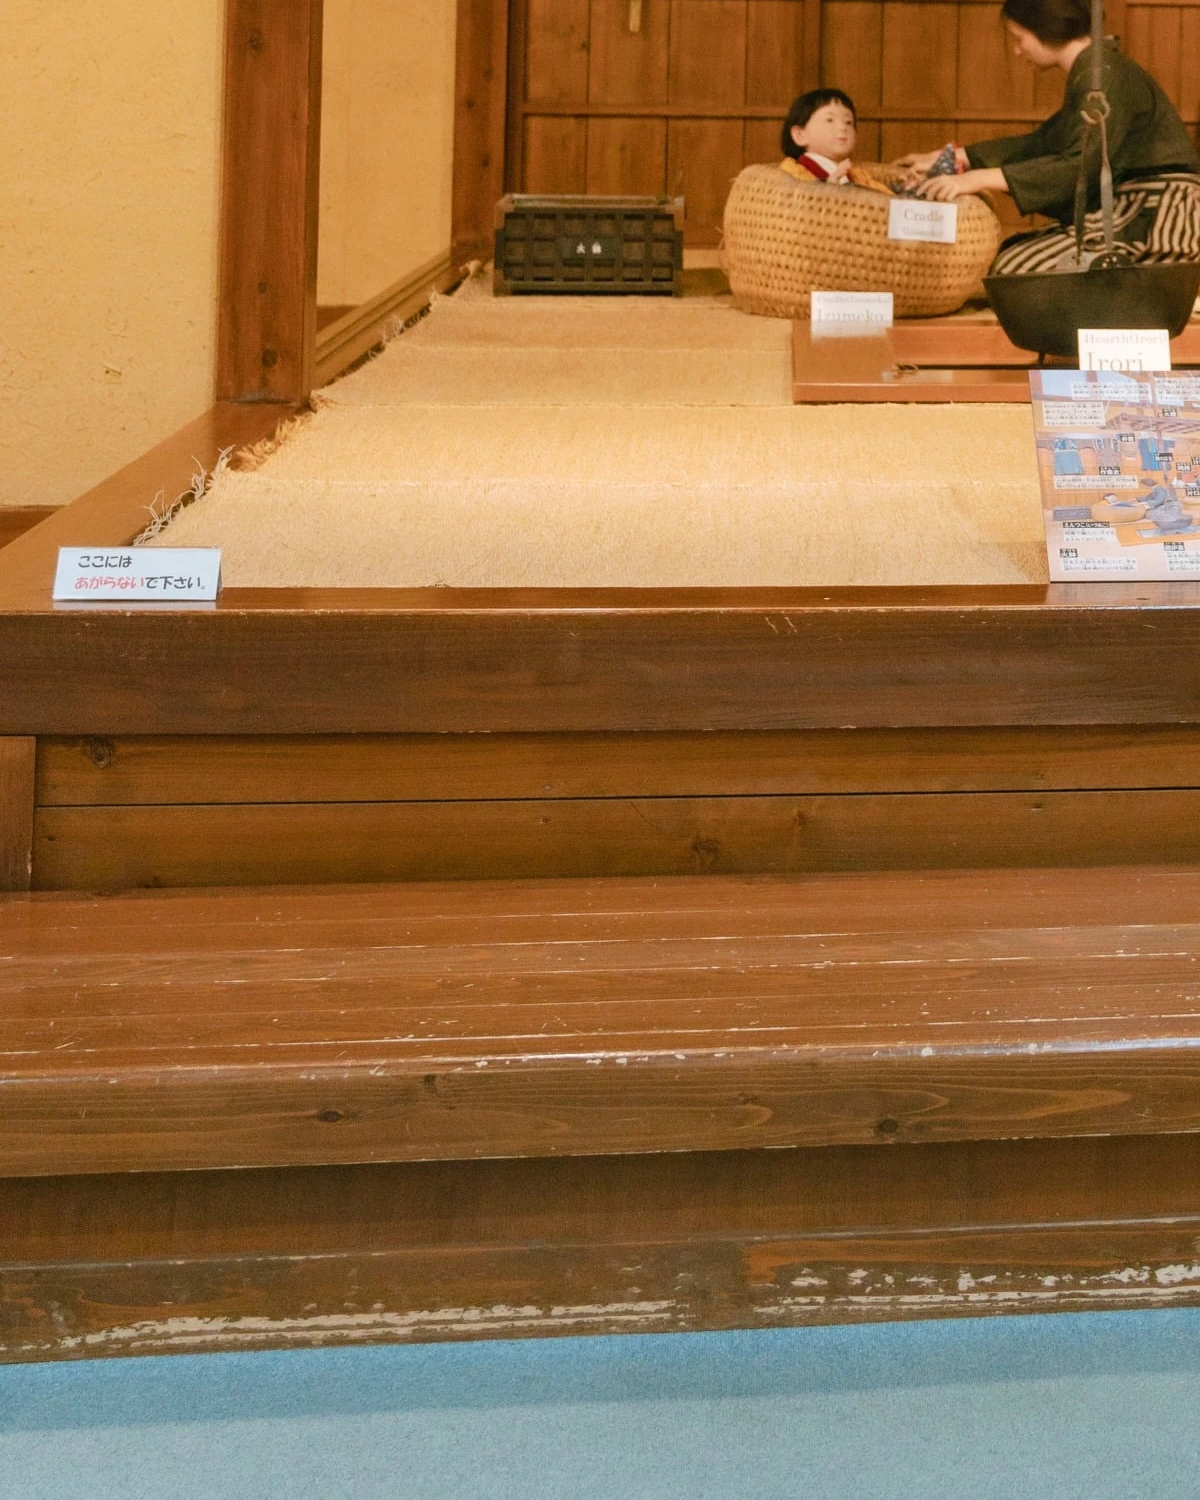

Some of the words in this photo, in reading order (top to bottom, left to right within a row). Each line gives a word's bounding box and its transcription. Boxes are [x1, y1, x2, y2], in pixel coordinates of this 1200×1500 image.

[904, 208, 945, 222] Cradle
[817, 308, 884, 323] Izumeko
[1085, 351, 1143, 372] Irori
[78, 555, 133, 568] ここには
[74, 576, 206, 590] あがらないで下さい。
